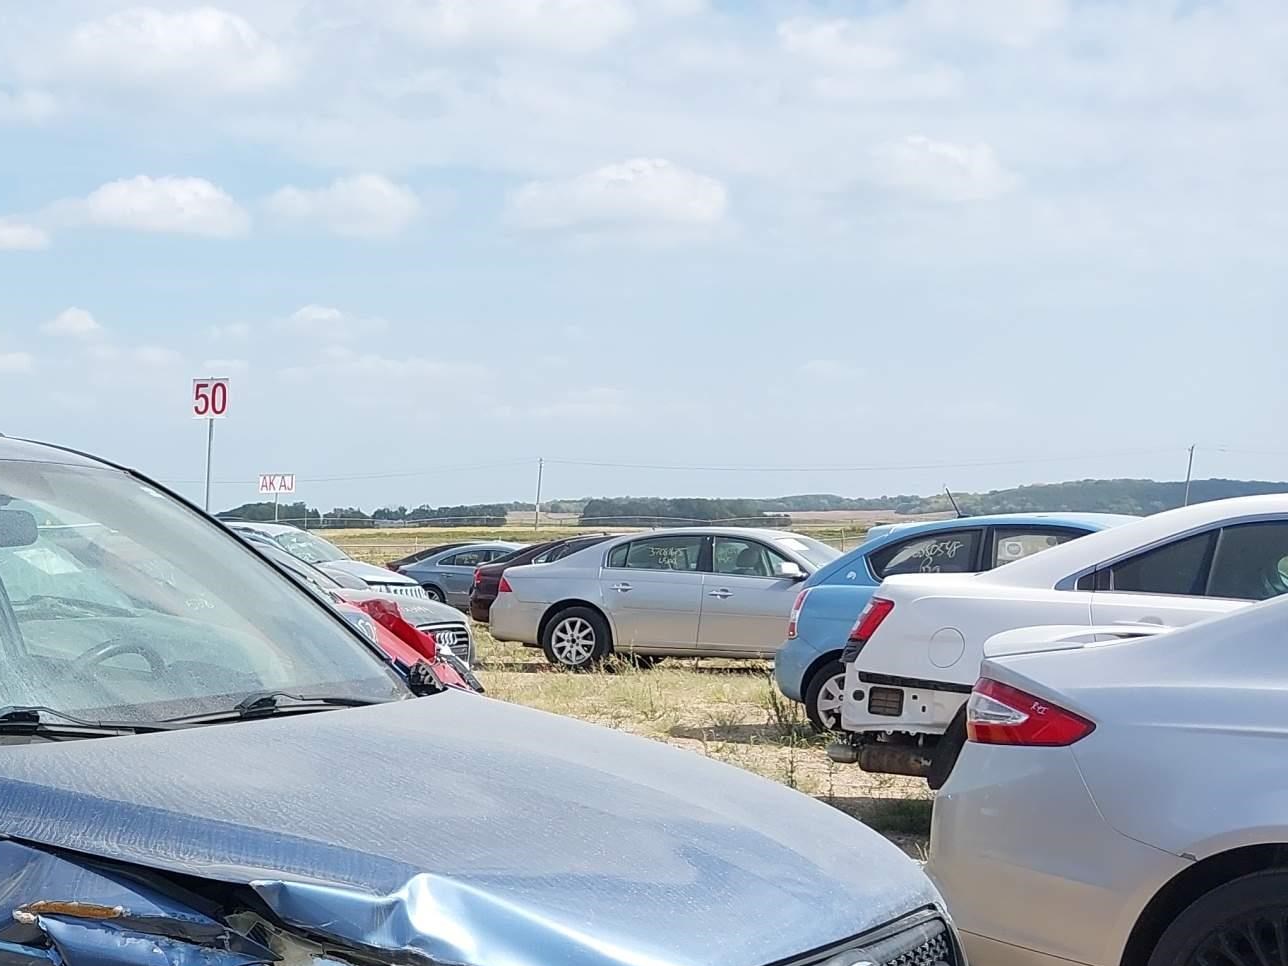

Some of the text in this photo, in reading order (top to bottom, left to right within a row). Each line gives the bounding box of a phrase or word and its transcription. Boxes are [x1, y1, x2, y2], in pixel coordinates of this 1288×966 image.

[193, 382, 227, 416] 50
[260, 475, 294, 491] AK AJ
